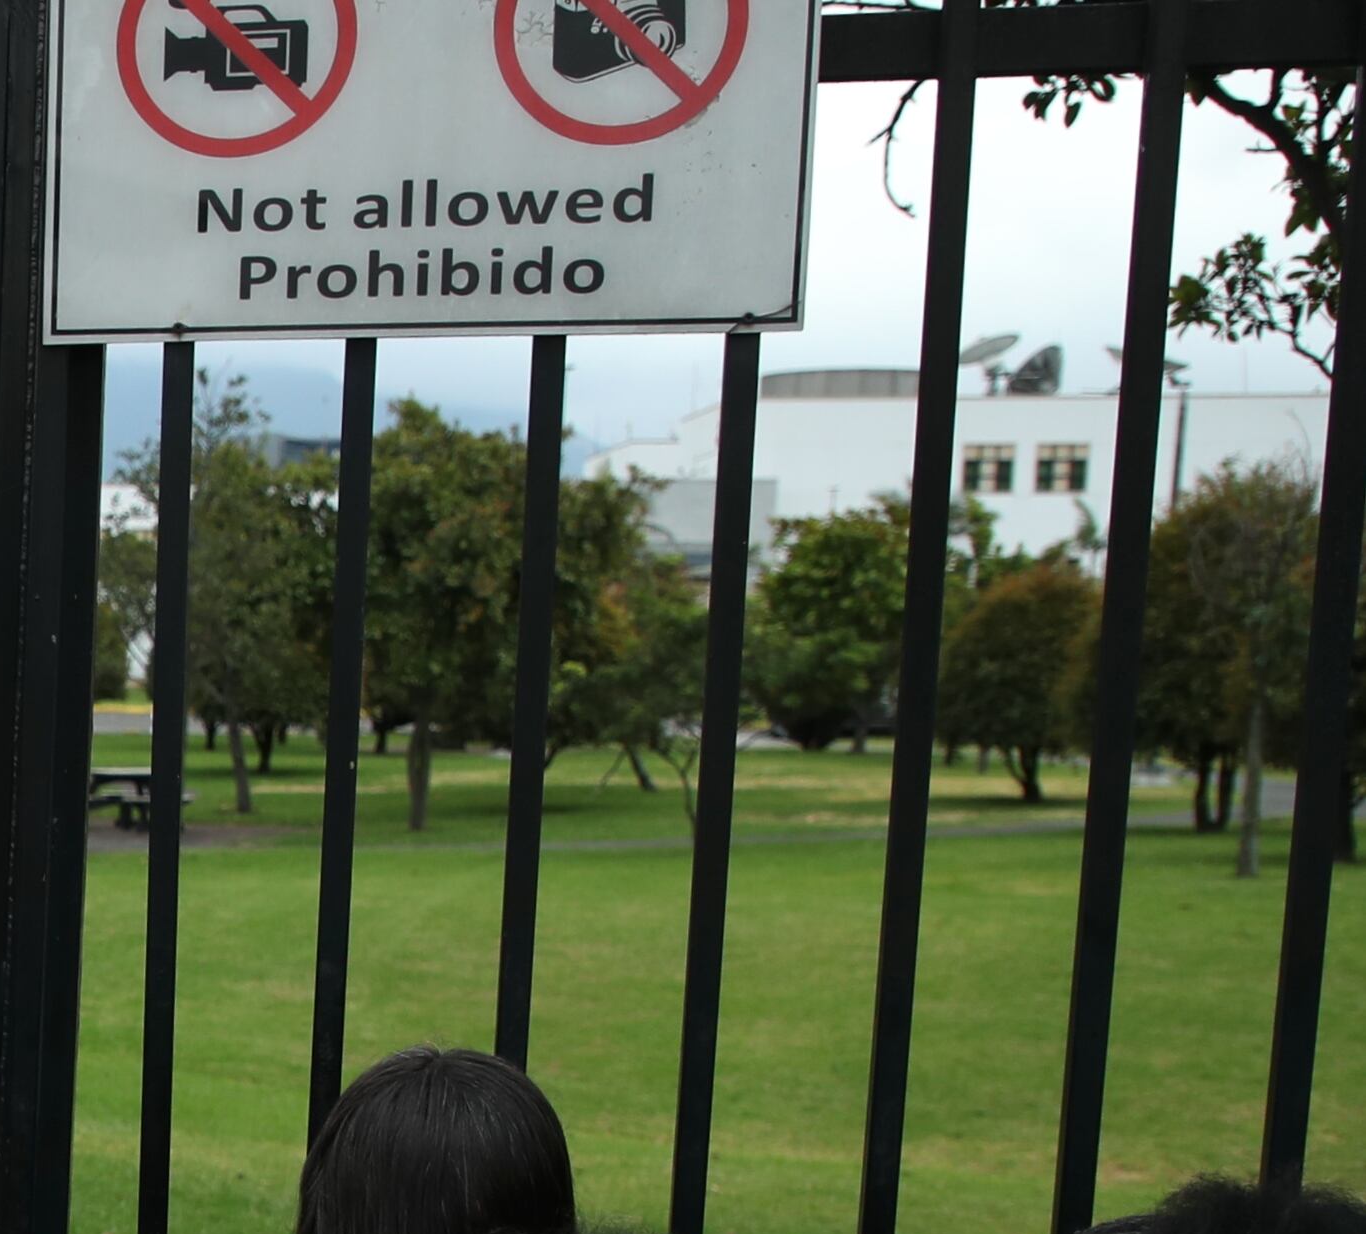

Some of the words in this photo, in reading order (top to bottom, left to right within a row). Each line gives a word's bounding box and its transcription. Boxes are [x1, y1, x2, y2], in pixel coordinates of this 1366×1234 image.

[196, 187, 327, 234] Not
[353, 172, 655, 232] allowed
[238, 245, 606, 301] Prohibido
